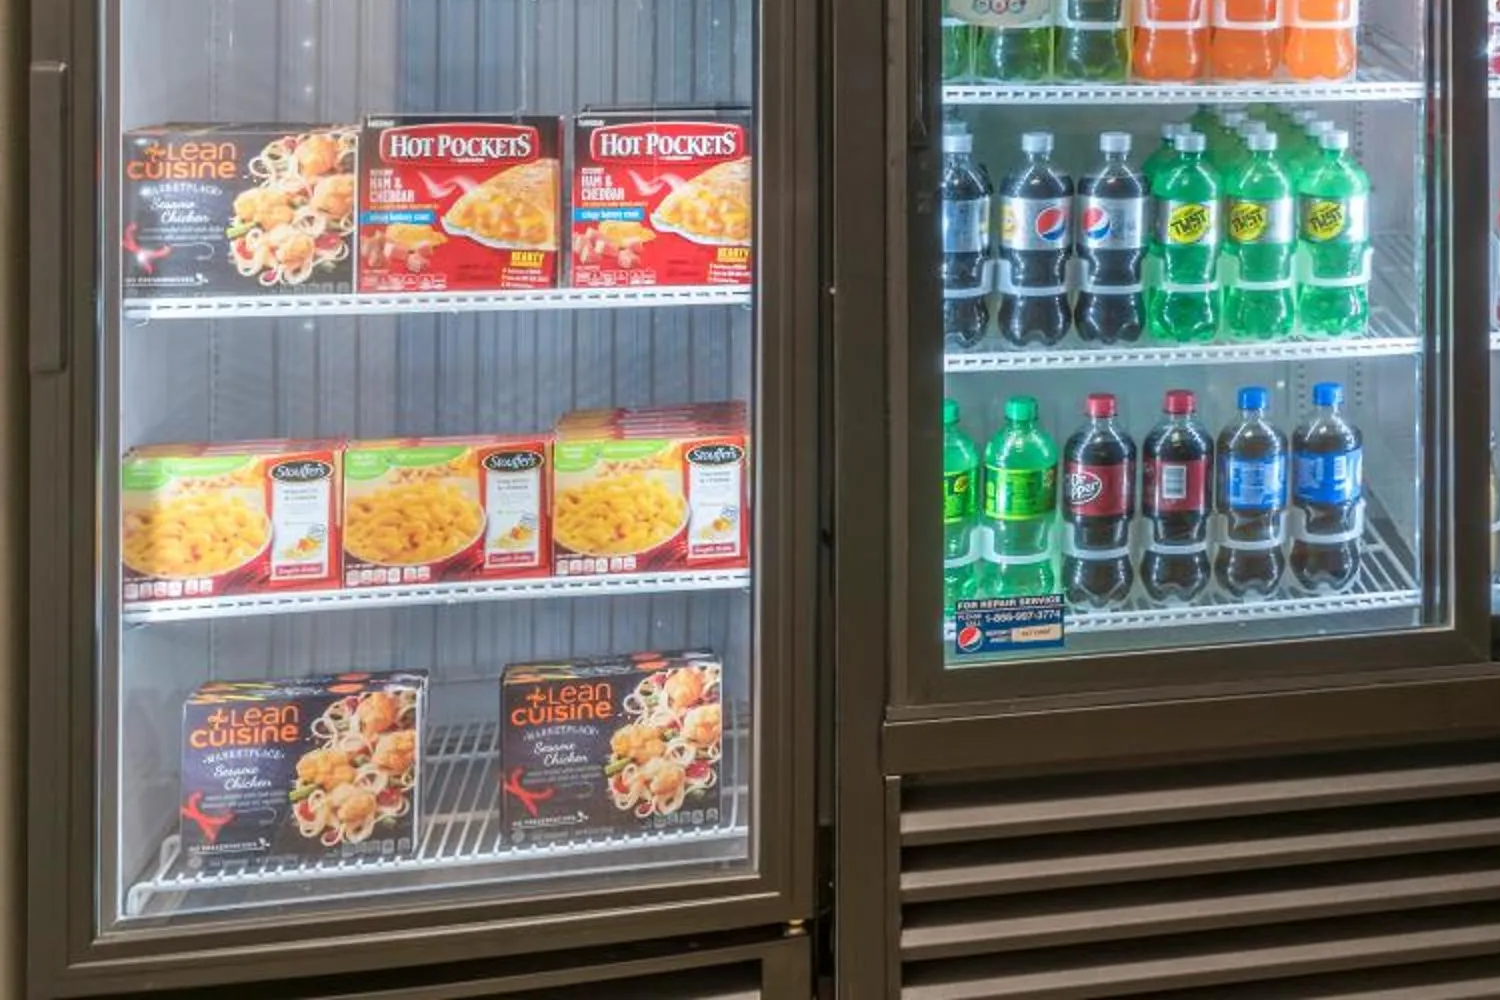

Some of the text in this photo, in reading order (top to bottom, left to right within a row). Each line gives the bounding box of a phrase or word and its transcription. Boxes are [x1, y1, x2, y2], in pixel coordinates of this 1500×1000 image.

[391, 132, 532, 158] HOT POCKETS
[600, 131, 736, 157] HOT POCKETS
[549, 682, 612, 705] Lean
[231, 705, 298, 727] Lean
